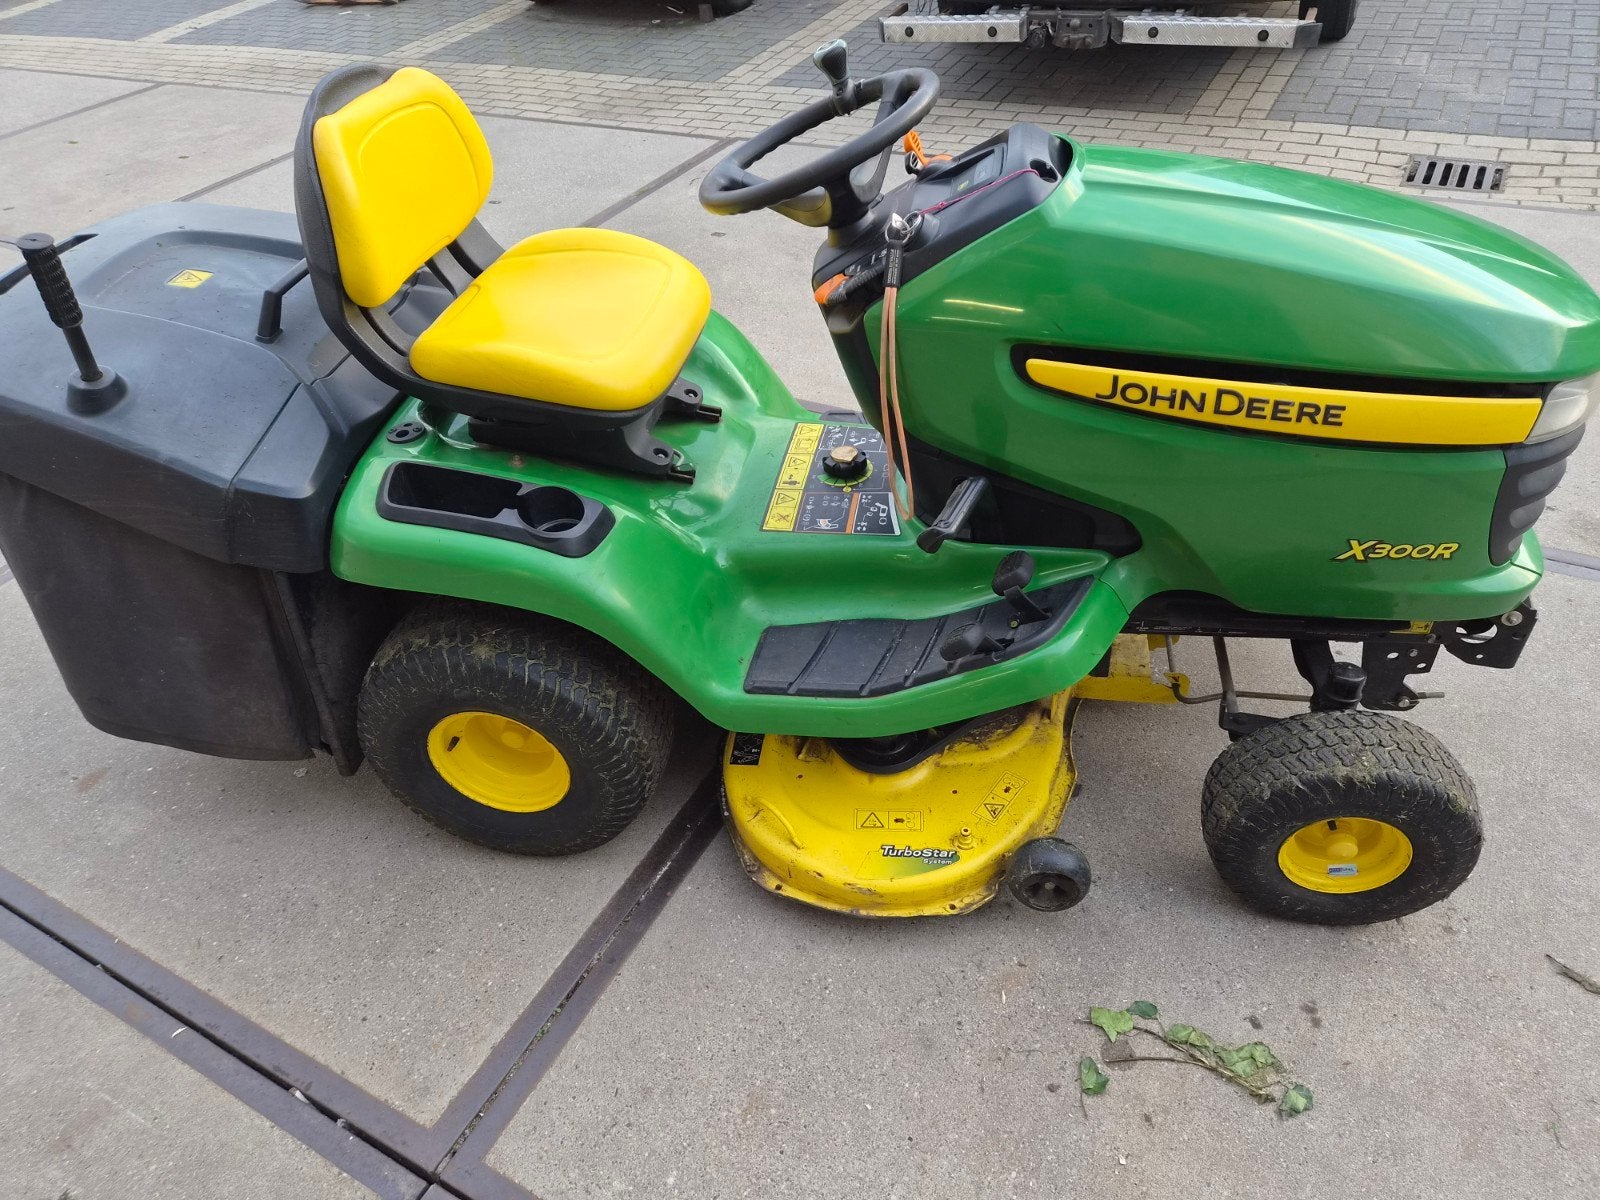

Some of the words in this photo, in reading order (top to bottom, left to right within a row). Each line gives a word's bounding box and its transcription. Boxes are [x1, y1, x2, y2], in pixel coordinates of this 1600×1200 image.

[1095, 375, 1207, 413] JOHN
[1213, 388, 1347, 427] DEERE
[1331, 538, 1460, 561] X300R
[881, 845, 957, 858] TurboStar
